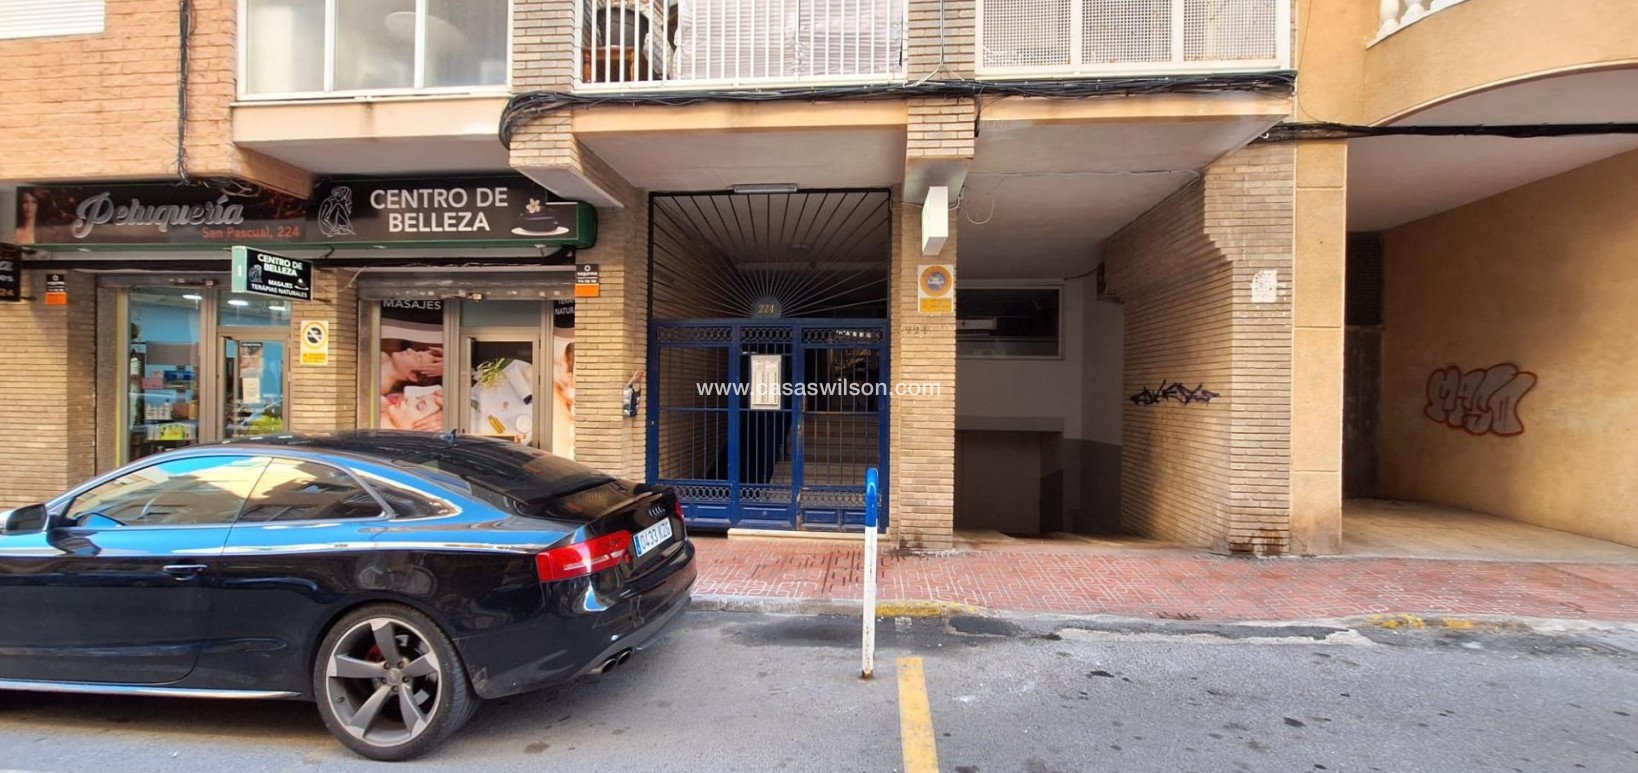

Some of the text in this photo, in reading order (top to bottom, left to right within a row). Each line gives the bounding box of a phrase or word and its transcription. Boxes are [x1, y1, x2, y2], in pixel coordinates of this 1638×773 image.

[370, 187, 509, 210] CENTRO DE
[71, 191, 245, 239] Peluquería
[388, 211, 491, 233] BELLEZA
[202, 225, 301, 240] San Pascual, 224
[257, 254, 303, 271] CENTRO DE
[263, 263, 297, 277] BELLEZA
[383, 299, 442, 311] MASAJES
[758, 303, 775, 314] 224
